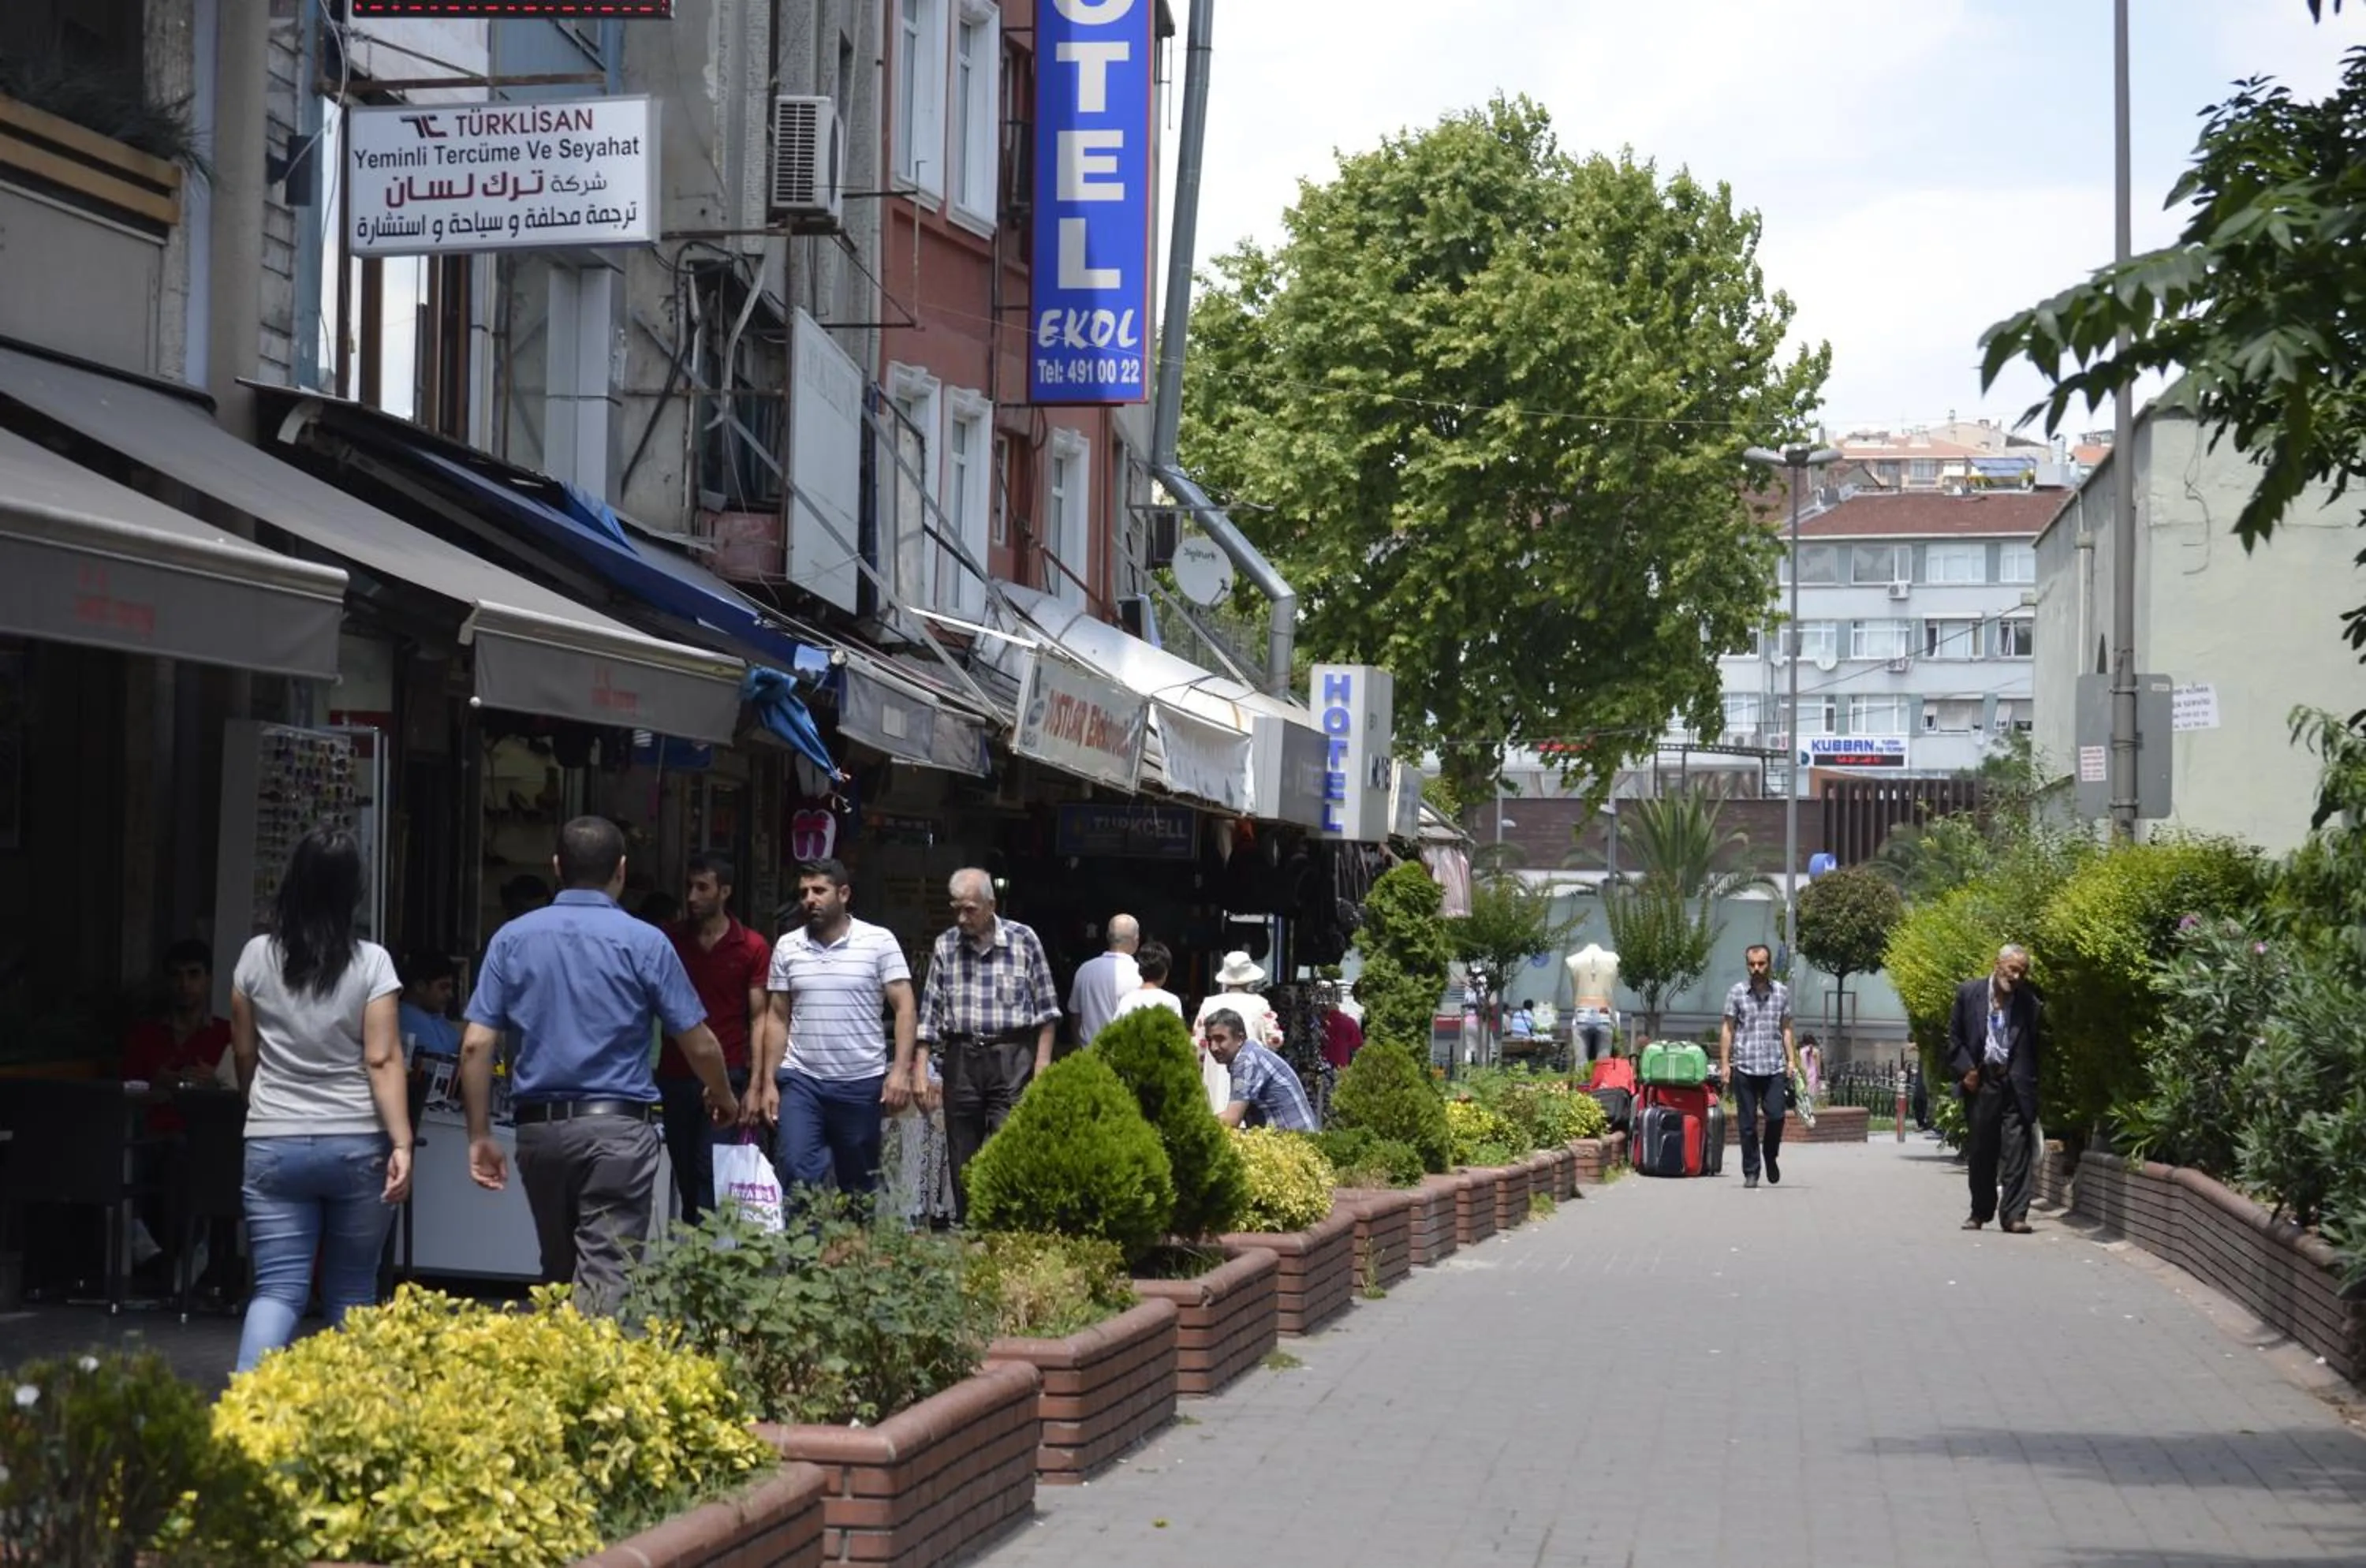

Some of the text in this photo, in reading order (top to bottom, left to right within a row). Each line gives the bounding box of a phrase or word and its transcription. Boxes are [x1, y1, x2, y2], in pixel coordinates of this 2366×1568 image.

[456, 106, 594, 137] TÜRKLİSAN
[354, 136, 640, 168] Yeminli Tercüme Ve Seyahat
[386, 170, 606, 207] شركة ترك لسان
[356, 202, 636, 245] ترجمة محلفة و سياحة و استشارة
[1038, 308, 1138, 349] EKOL
[1038, 359, 1140, 383] Tel: 491 00 22
[1322, 674, 1351, 831] HOTEL
